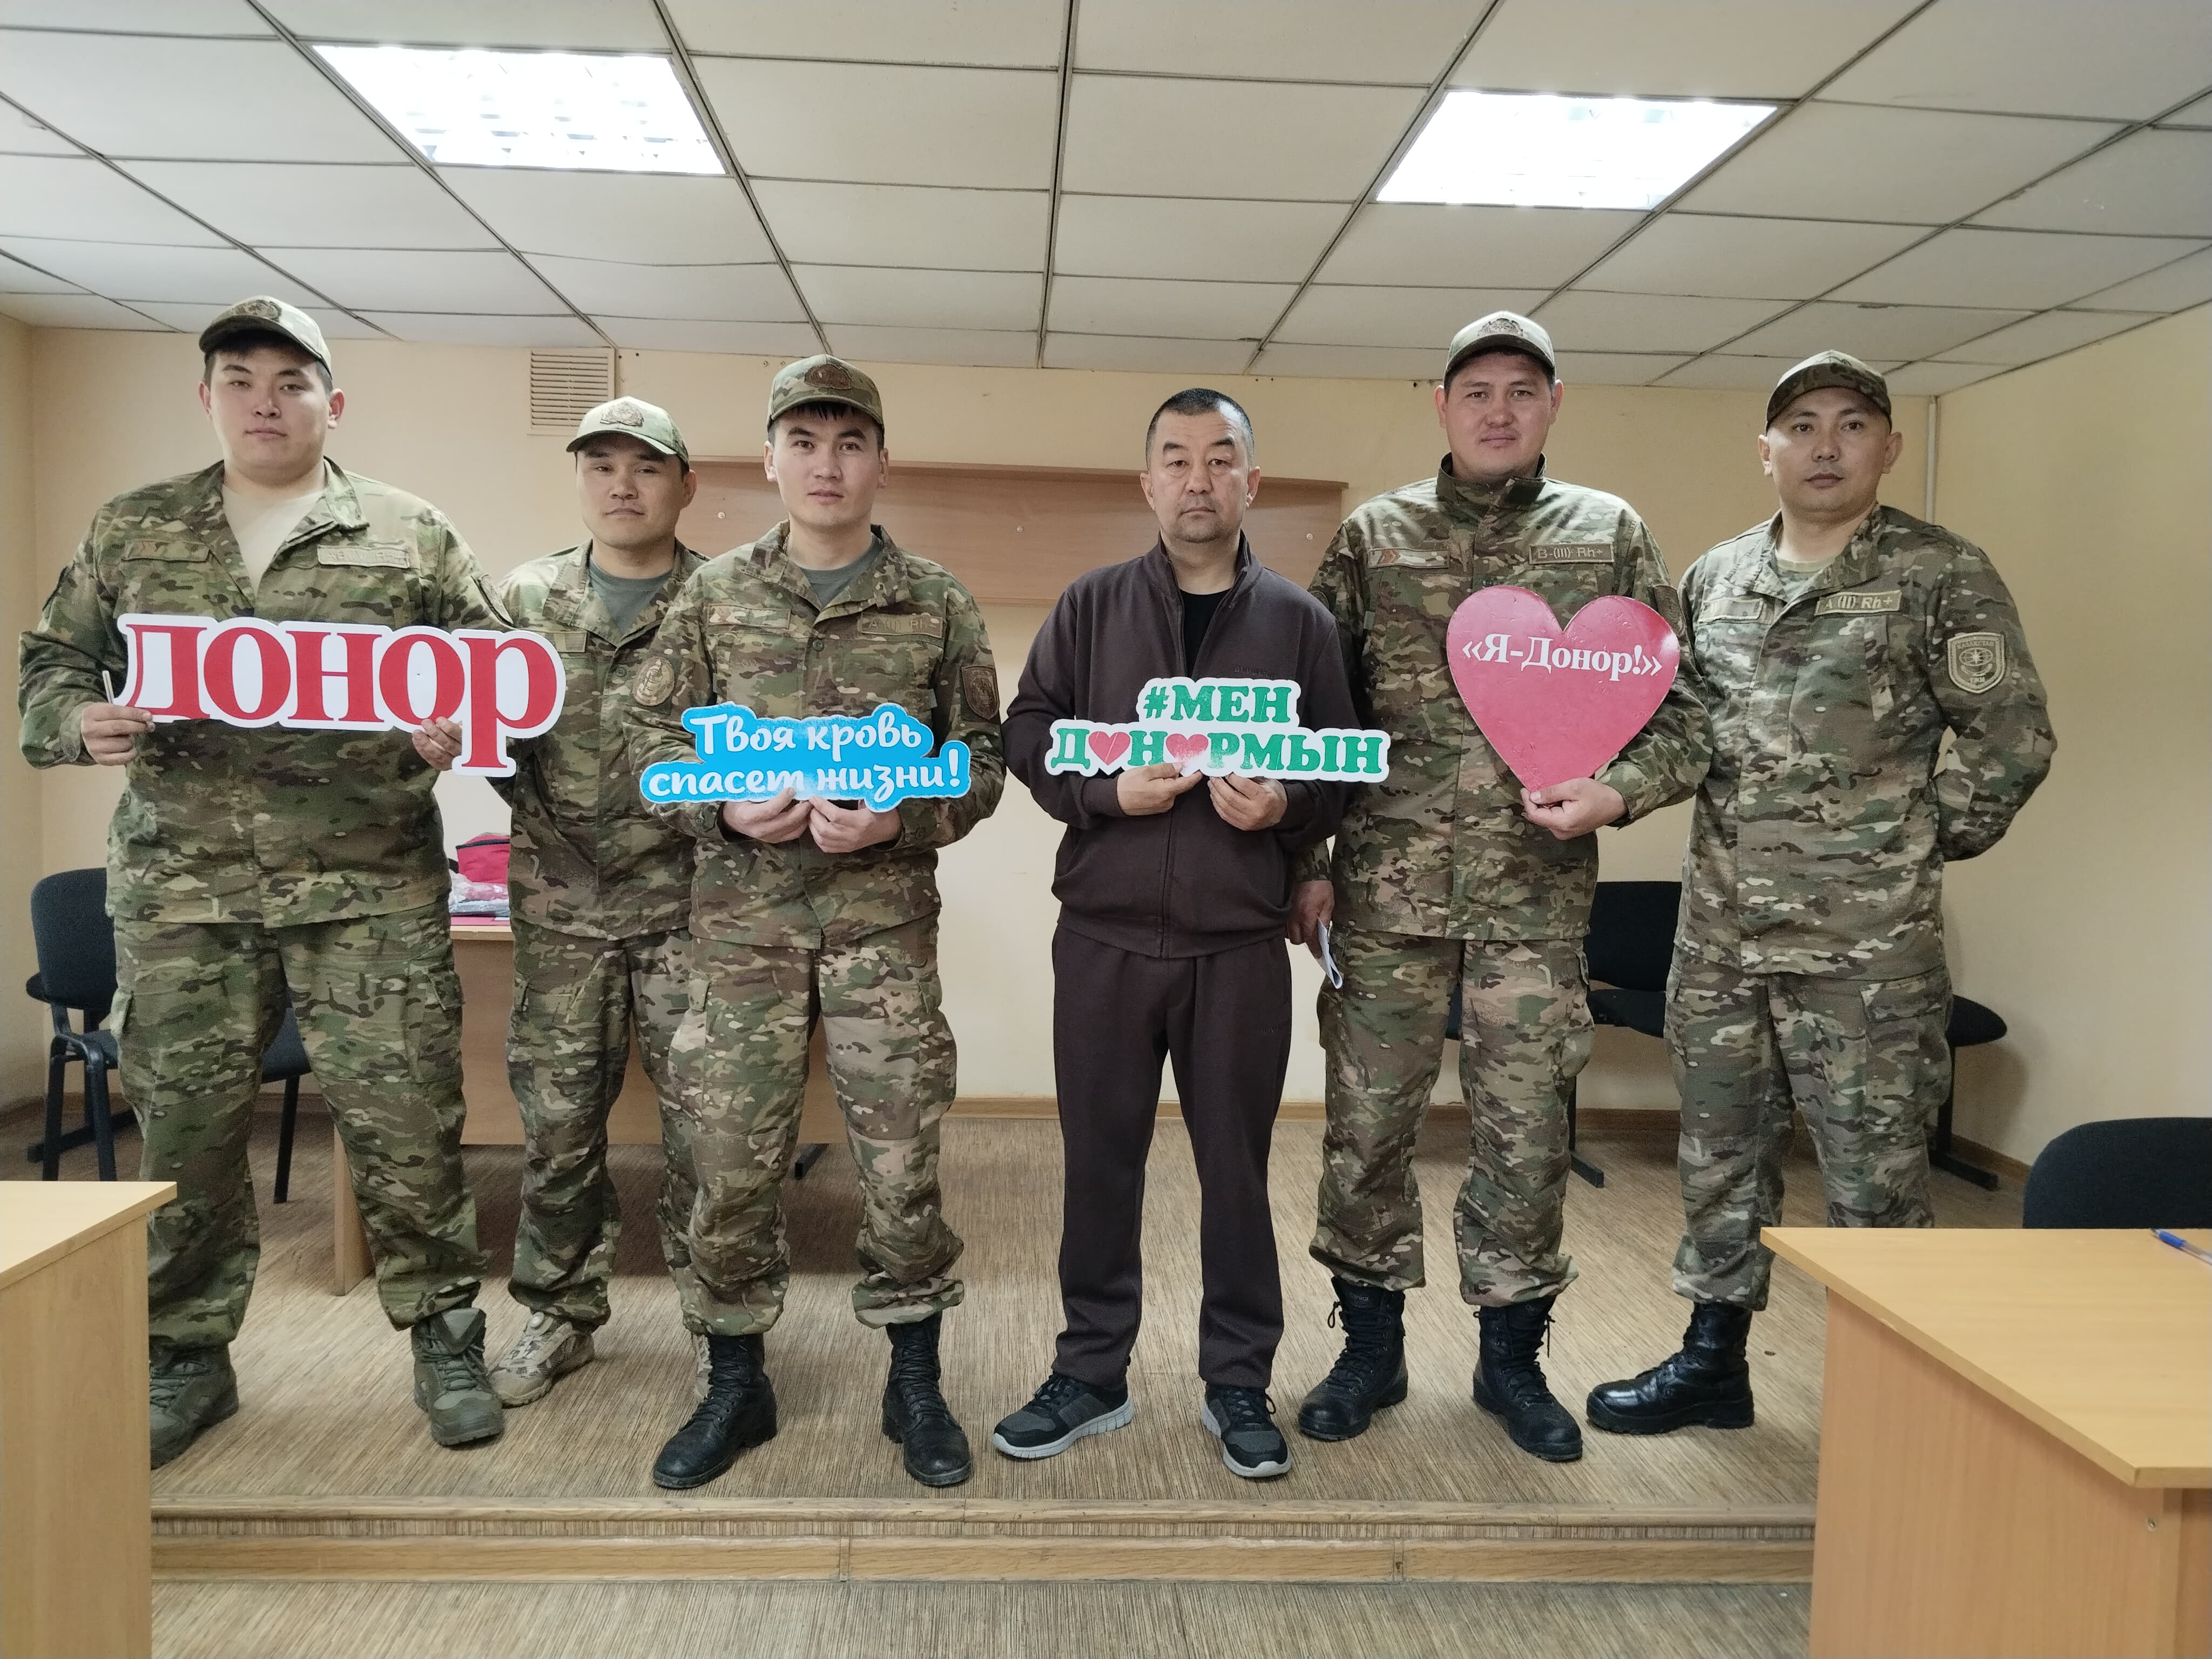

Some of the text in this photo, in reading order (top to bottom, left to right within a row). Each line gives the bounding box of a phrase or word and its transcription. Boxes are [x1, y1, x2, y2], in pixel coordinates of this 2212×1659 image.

[1577, 547, 1603, 558] Rh+
[1824, 598, 1832, 609] A
[1861, 596, 1893, 609] Rh+
[1143, 684, 1292, 723] #МЕН
[690, 711, 922, 762] Твоя кровь
[649, 748, 959, 802] спасет жизни!
